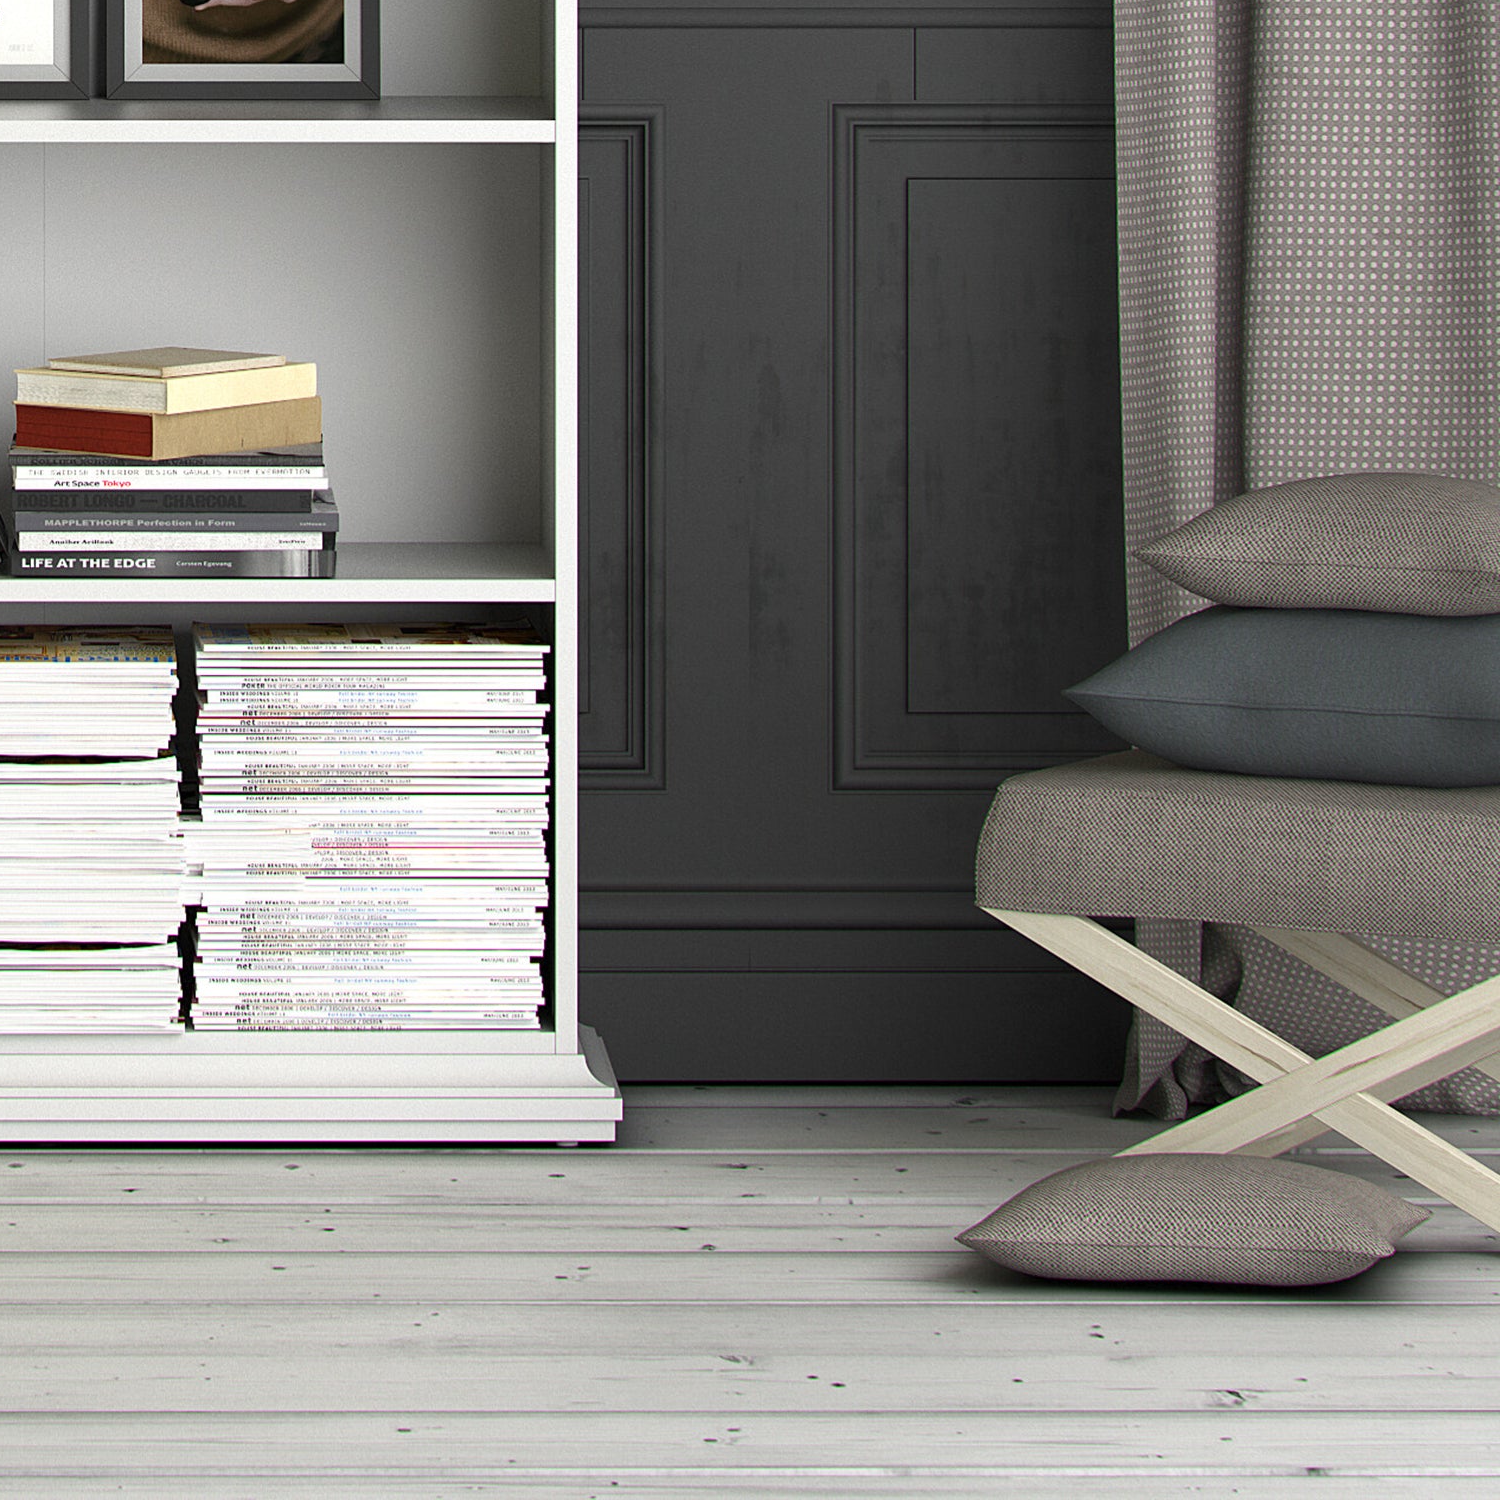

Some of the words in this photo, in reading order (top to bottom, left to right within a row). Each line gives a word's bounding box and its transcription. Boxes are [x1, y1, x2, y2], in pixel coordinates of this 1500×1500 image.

[72, 480, 101, 489] Space
[102, 480, 132, 489] Tokyo
[17, 494, 79, 508] ROBERT
[84, 494, 136, 508] LONGO
[163, 494, 247, 508] CHARCOAL
[44, 519, 135, 527] MAPPLETHORPE
[137, 519, 192, 527] Perfection
[195, 519, 205, 527] in
[208, 519, 236, 527] Form
[21, 558, 53, 568] LIFE
[56, 558, 77, 568] AT
[79, 558, 110, 568] THE
[113, 558, 156, 568] EDGE
[203, 560, 233, 568] Egevang
